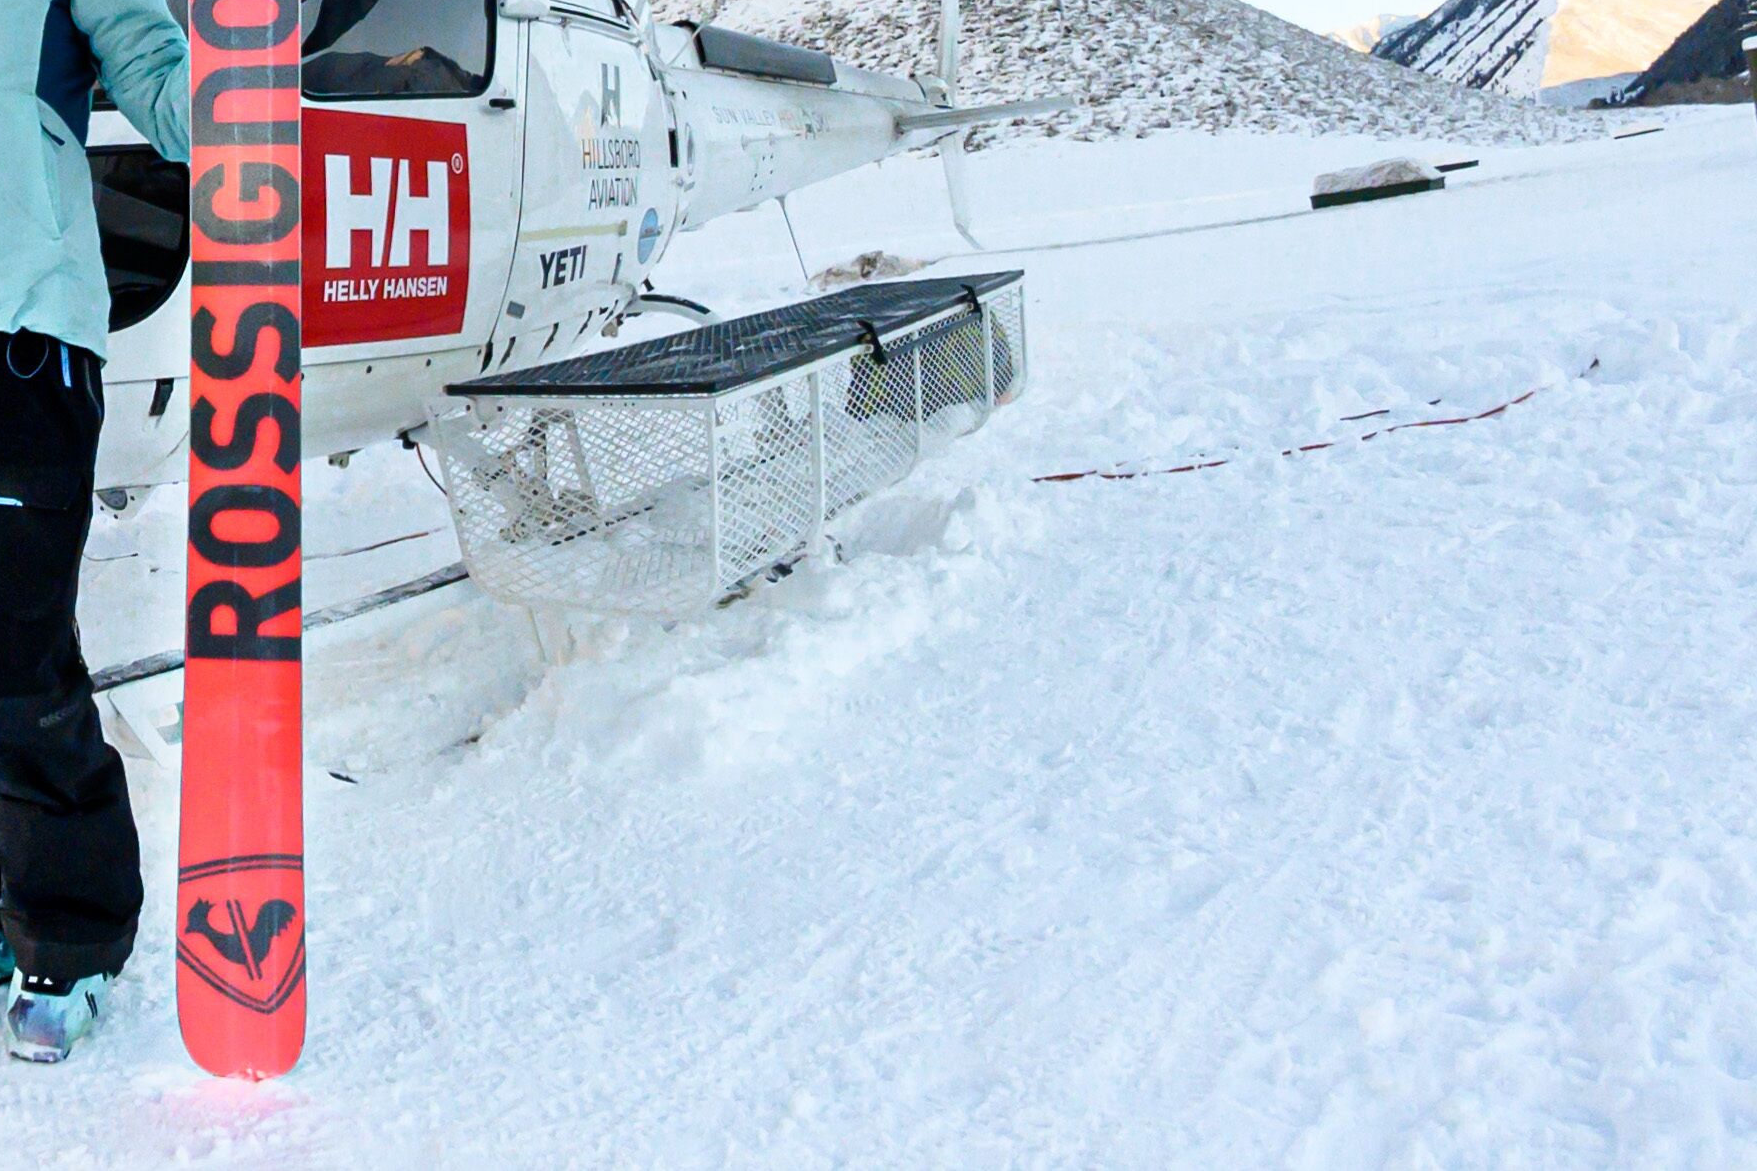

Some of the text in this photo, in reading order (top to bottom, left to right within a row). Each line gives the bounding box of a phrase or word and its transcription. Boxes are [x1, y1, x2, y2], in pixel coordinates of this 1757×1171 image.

[581, 138, 641, 170] HILLSBORO
[324, 153, 450, 269] HH
[588, 178, 638, 211] AVIATION
[539, 244, 588, 290] YETI
[323, 276, 448, 303] HELLY HANSEN
